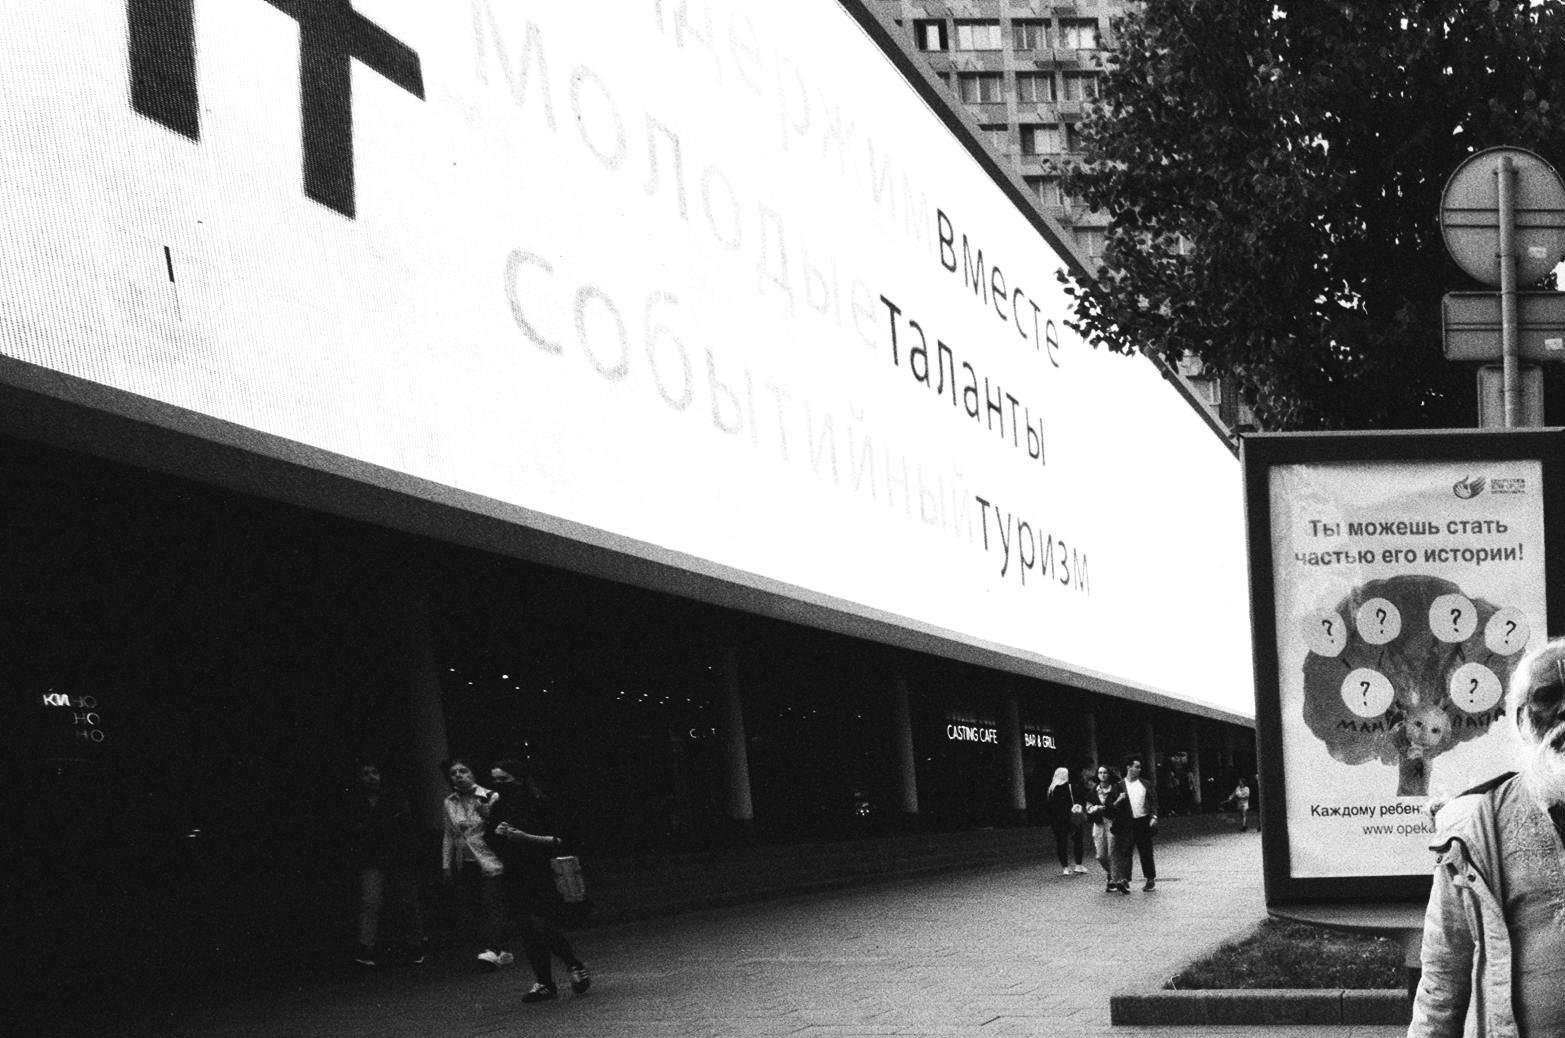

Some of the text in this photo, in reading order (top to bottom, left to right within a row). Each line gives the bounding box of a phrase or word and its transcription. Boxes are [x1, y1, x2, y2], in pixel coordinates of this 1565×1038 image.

[935, 207, 1061, 368] вместе
[878, 292, 1047, 467] таланты
[1308, 519, 1508, 537] Ты можешь стать
[974, 494, 1090, 597] туризм
[1295, 543, 1524, 565] частью его истории!
[946, 724, 998, 744] CASTING CAFE
[1310, 804, 1376, 818] Каждому
